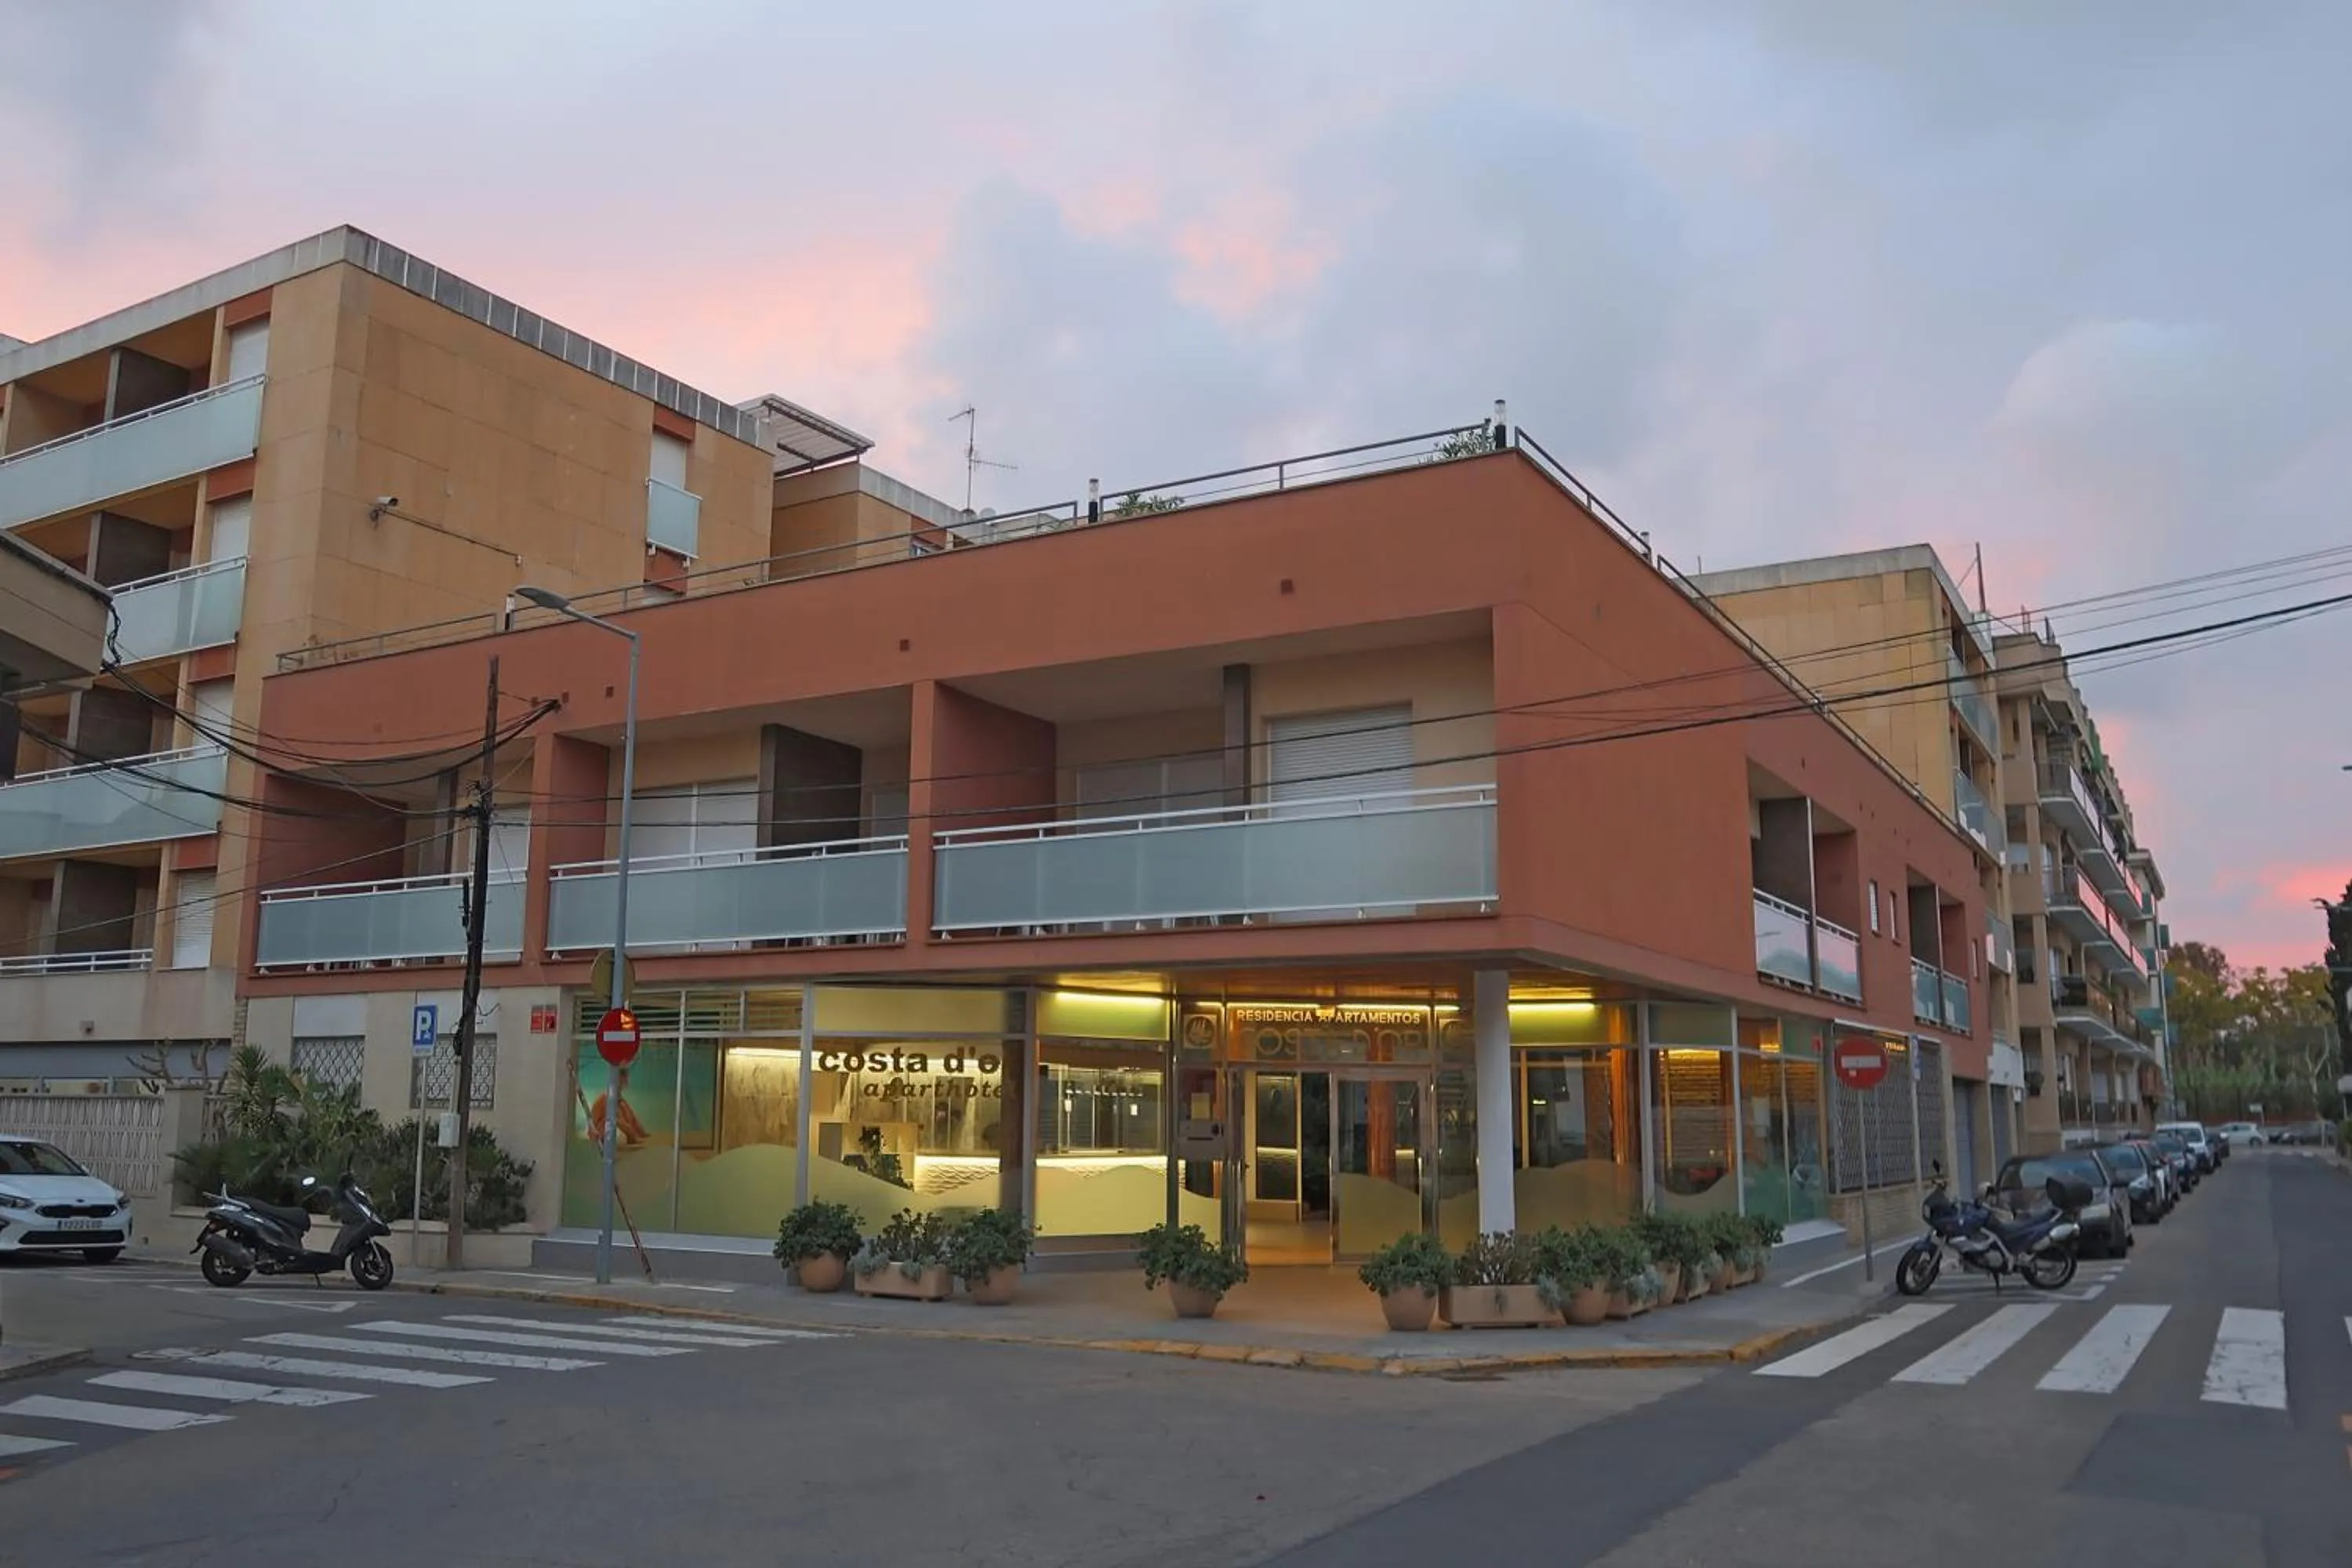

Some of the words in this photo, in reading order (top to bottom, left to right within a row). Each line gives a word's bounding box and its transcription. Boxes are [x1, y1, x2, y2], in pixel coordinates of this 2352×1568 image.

[416, 1010, 432, 1040] P
[1236, 1009, 1312, 1022] RESIDENCIA
[818, 1047, 928, 1073] costa
[944, 1046, 1000, 1074] d'o
[863, 1079, 1004, 1102] aparthote
